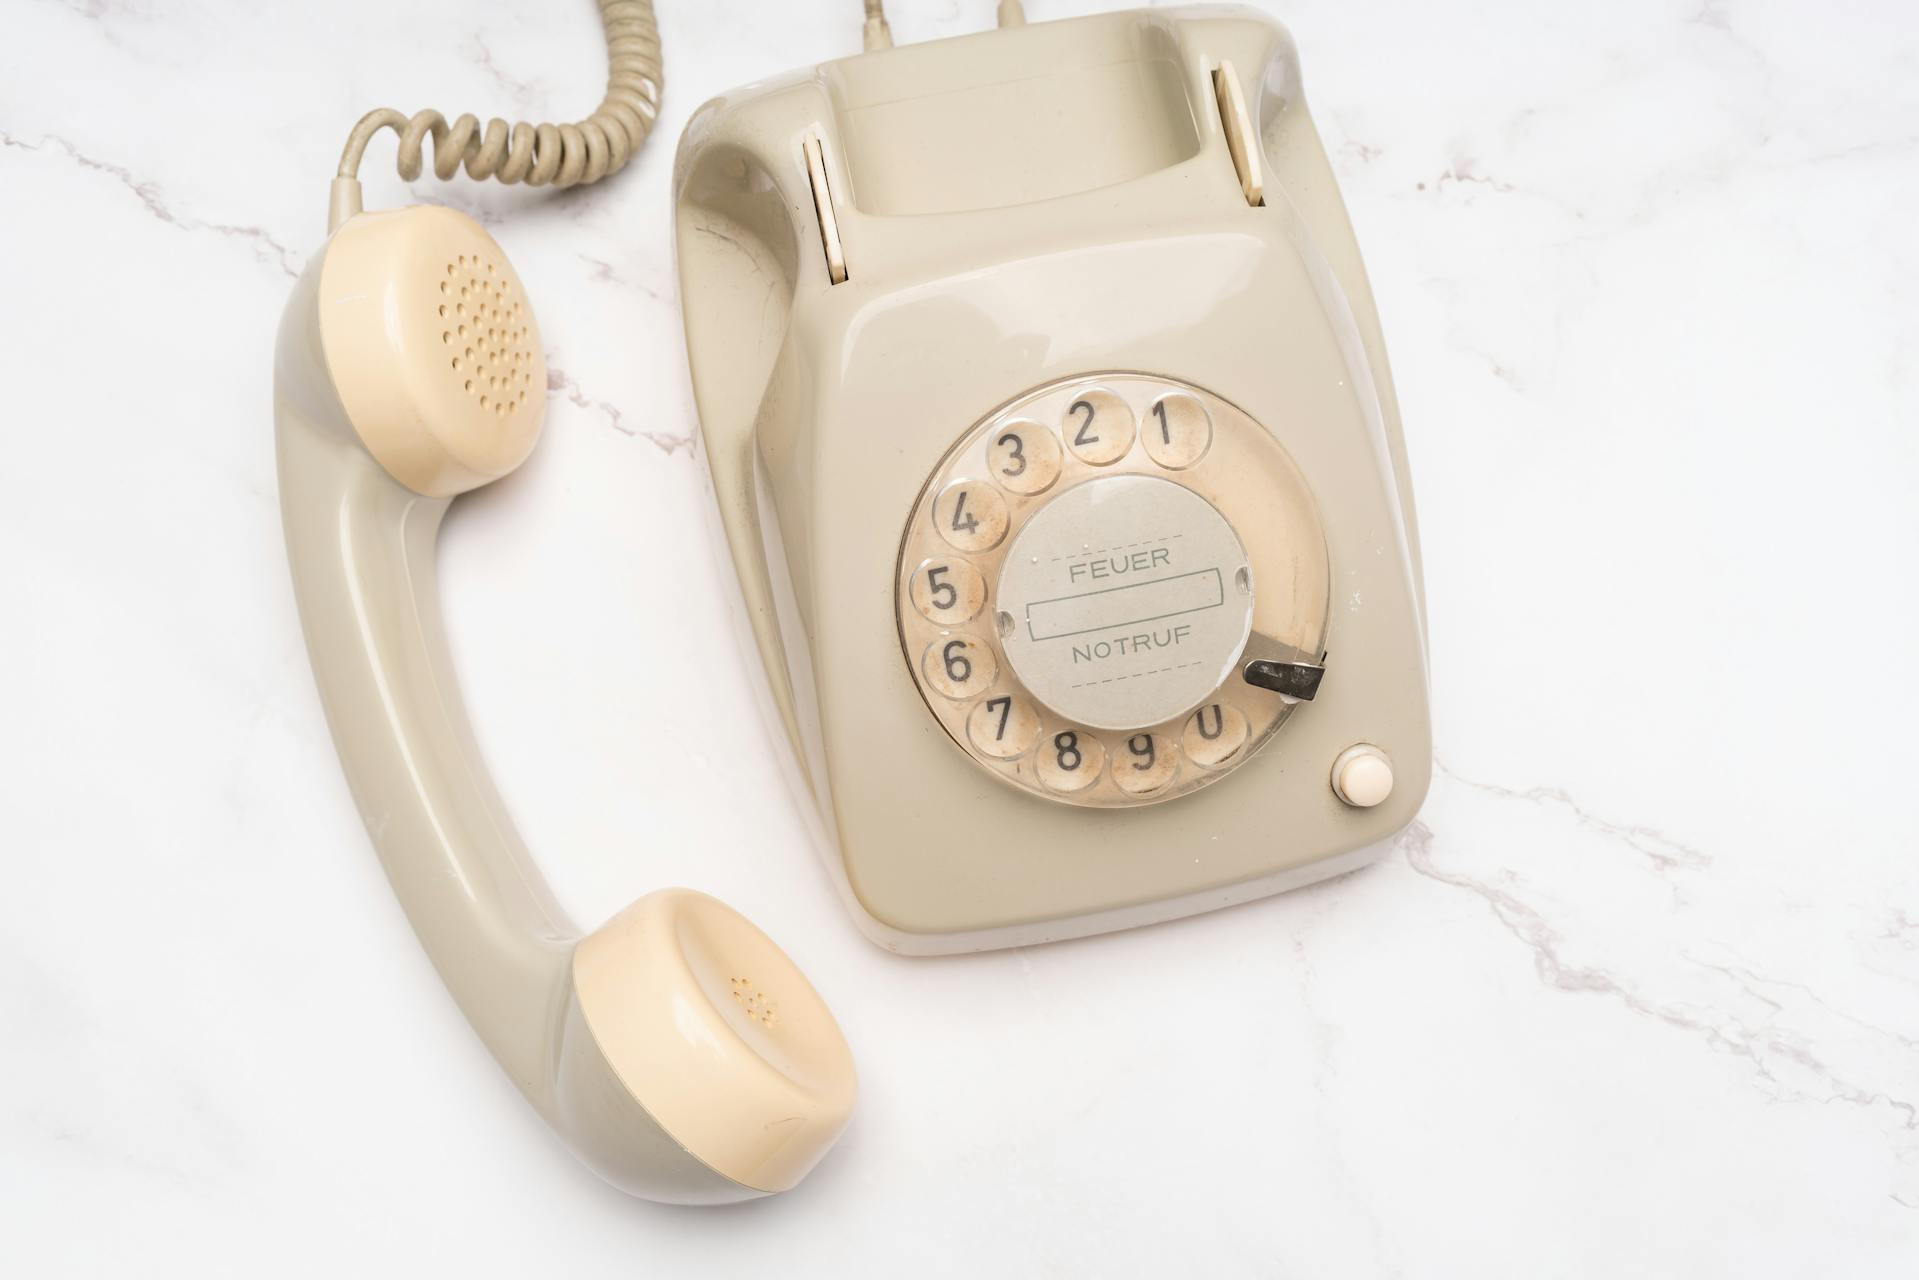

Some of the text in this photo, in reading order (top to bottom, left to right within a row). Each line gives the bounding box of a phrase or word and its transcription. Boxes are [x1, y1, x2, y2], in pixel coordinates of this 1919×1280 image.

[1069, 400, 1100, 446] 2
[1152, 400, 1171, 445] 1
[998, 433, 1027, 477] 3
[952, 491, 980, 535] 4
[1069, 548, 1171, 583] FEUER
[928, 566, 957, 610] 5
[943, 640, 971, 682] 6
[1072, 625, 1192, 663] NOTRUF
[986, 696, 1012, 741] 7
[1054, 731, 1082, 771] 8
[1128, 734, 1156, 771] 9
